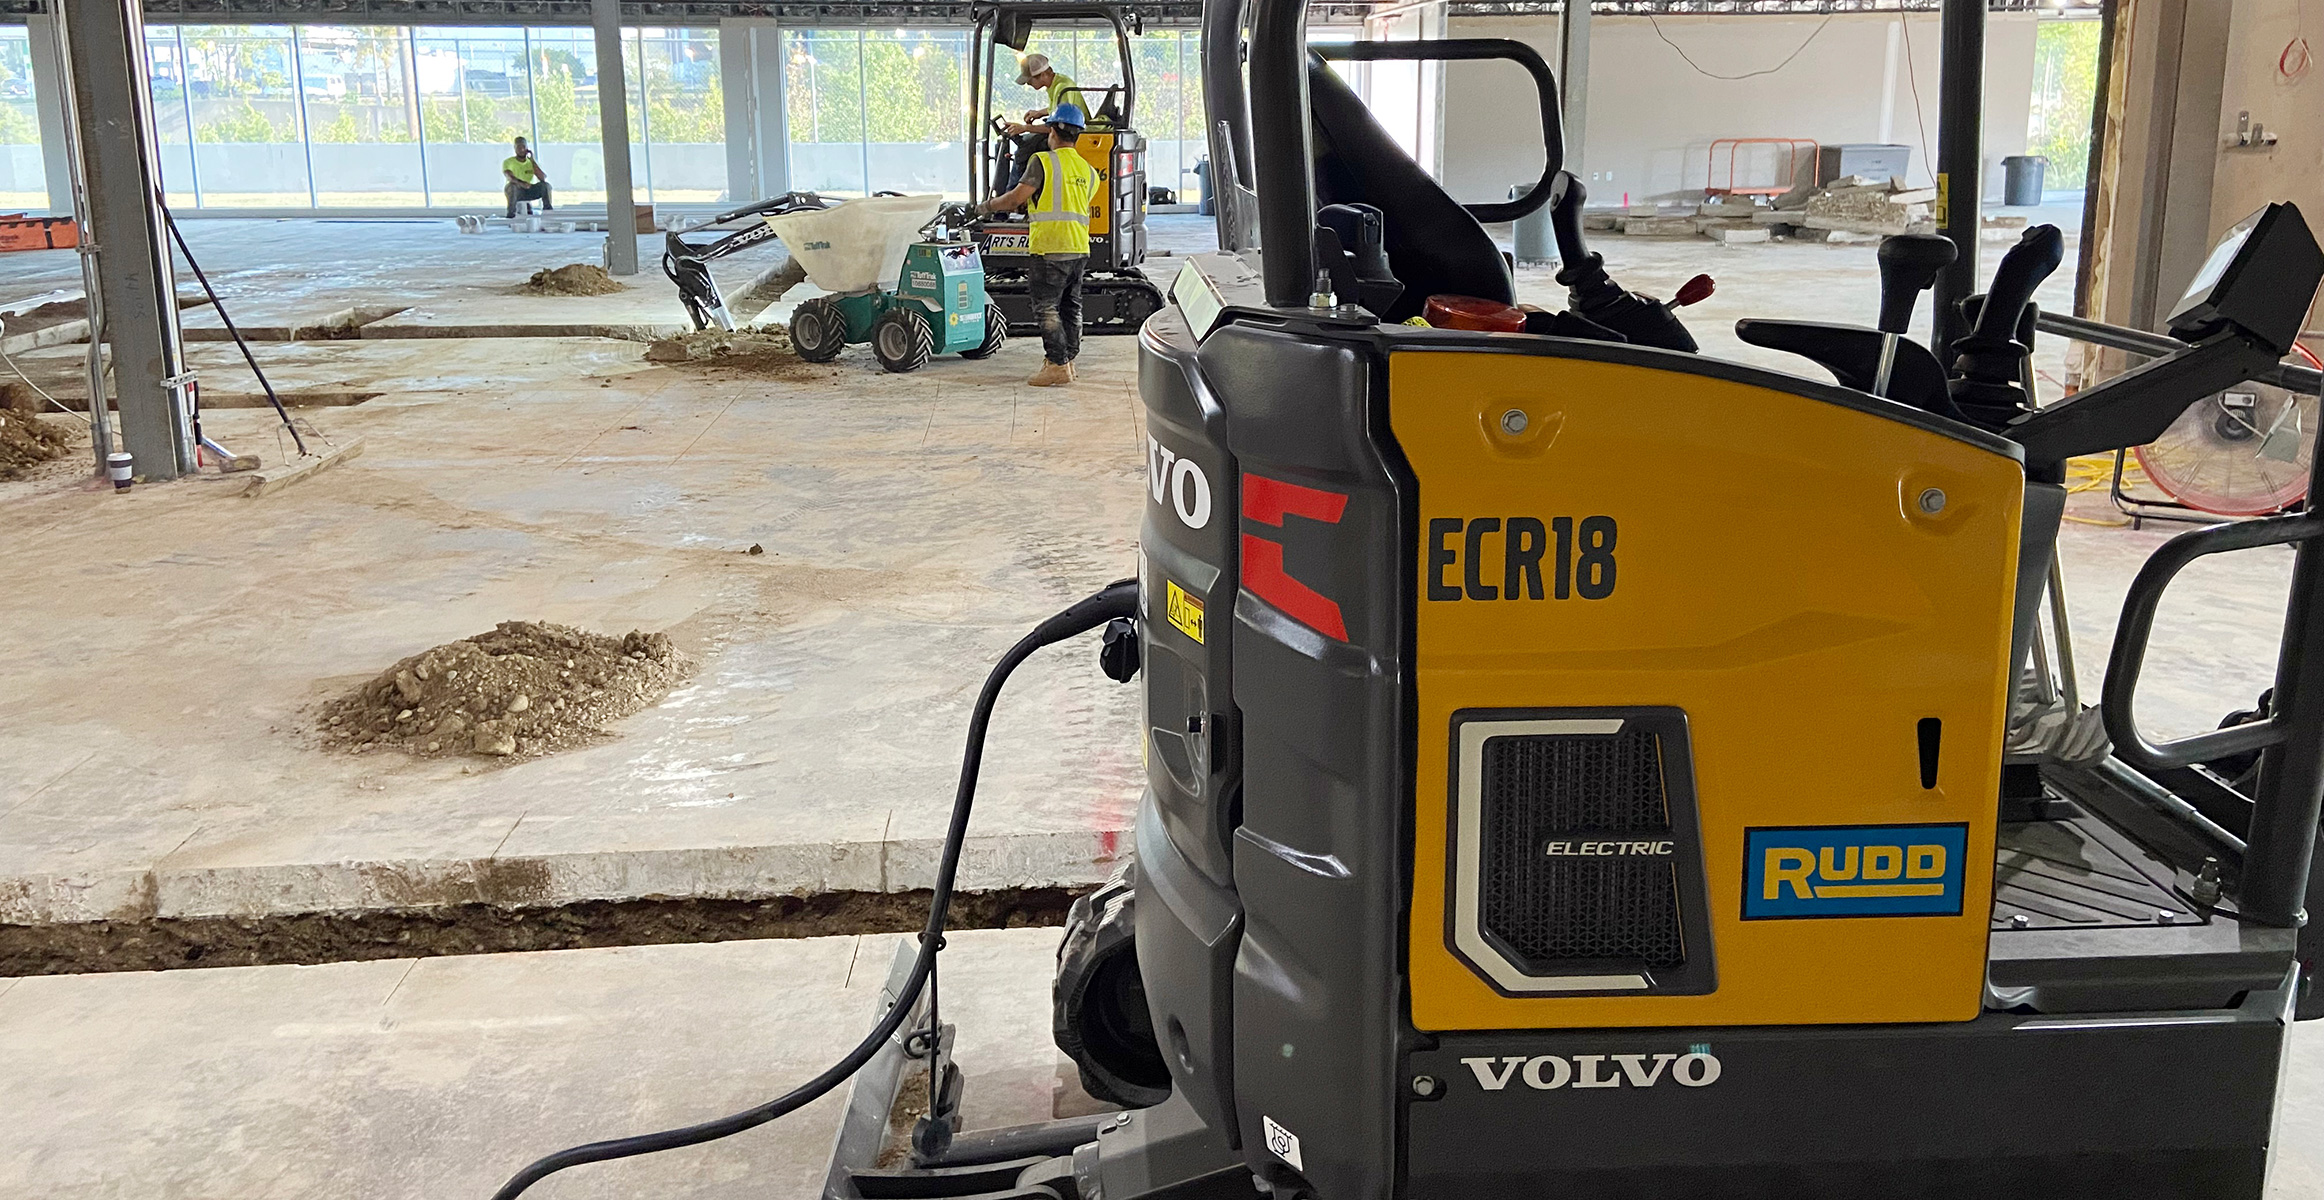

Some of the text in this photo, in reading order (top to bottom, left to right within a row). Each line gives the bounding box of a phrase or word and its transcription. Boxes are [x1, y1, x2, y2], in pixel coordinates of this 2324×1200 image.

[1089, 206, 1101, 218] 18
[980, 234, 1015, 254] ART'S
[1148, 436, 1211, 529] VO
[1427, 515, 1617, 601] ECR18
[1546, 841, 1674, 856] ELECTRIC
[1763, 845, 1947, 900] RUDD
[1461, 1053, 1722, 1090] VOLVO
